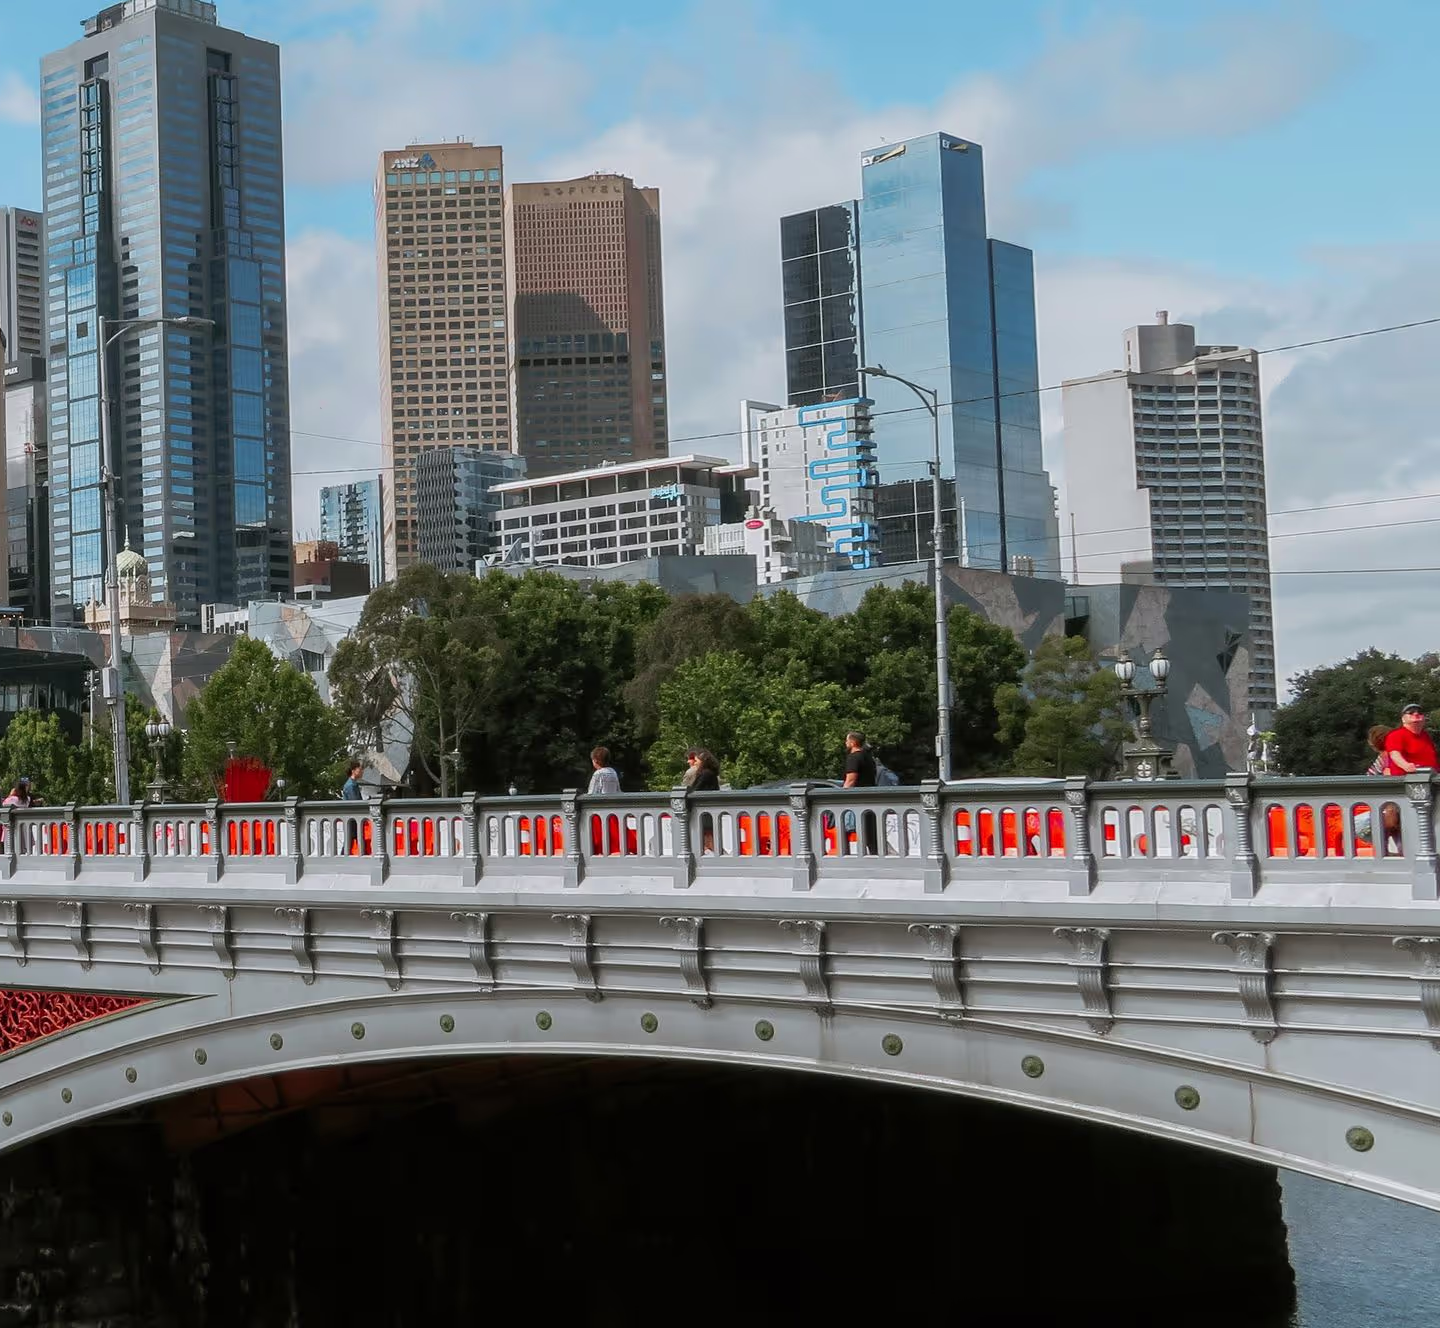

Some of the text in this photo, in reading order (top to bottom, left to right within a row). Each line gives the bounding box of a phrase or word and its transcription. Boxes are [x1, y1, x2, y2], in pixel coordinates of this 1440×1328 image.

[391, 158, 419, 169] ANZ
[862, 156, 874, 166] EY
[543, 185, 621, 196] SOFITEL
